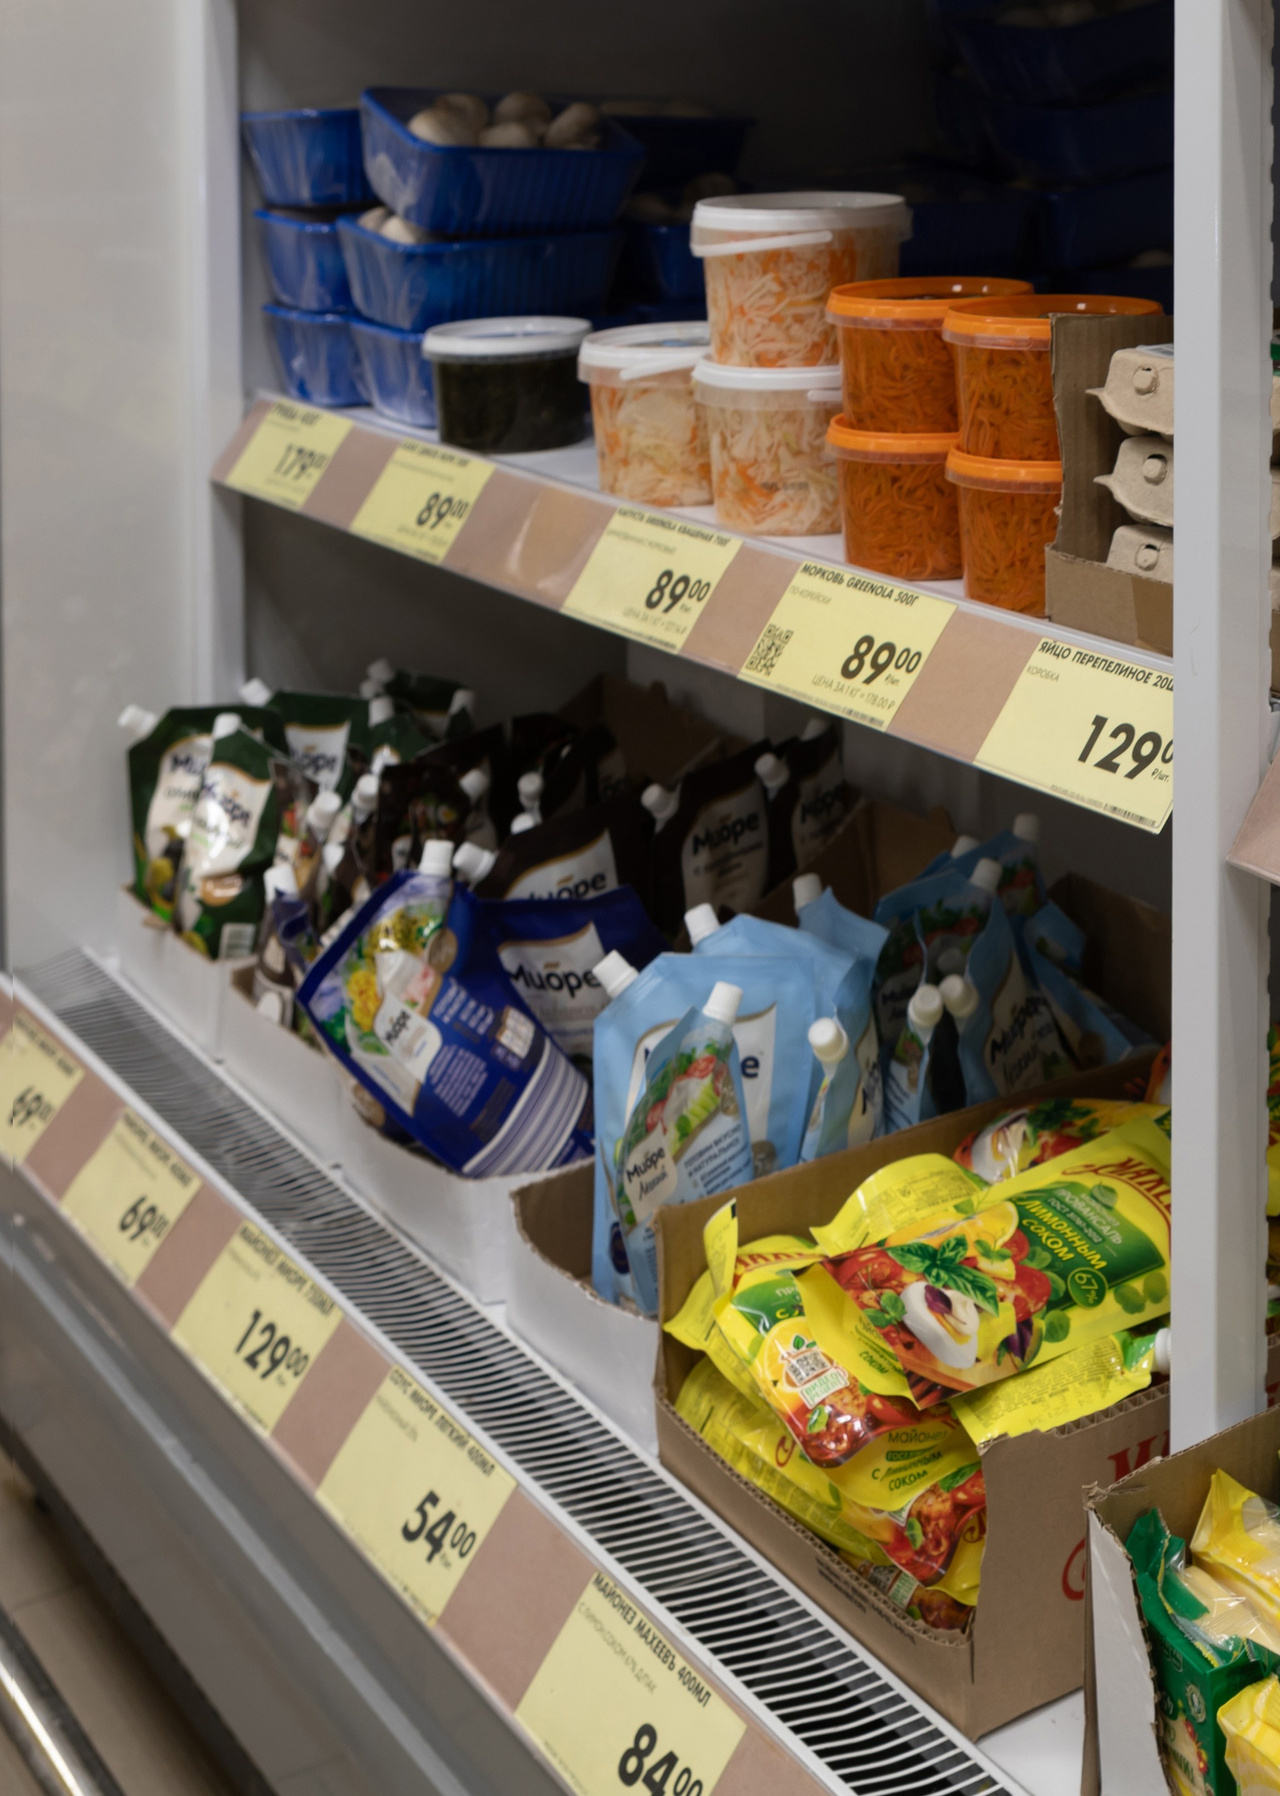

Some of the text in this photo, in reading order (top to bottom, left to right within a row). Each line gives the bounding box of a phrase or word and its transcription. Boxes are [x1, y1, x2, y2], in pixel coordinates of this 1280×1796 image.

[416, 491, 454, 530] 89
[645, 569, 711, 613] 89 00
[801, 563, 919, 606] МОРКОВЬ GREENOLA 500Г
[840, 634, 922, 685] 89 00
[1026, 664, 1060, 683] КОРОБКА
[1038, 639, 1071, 660] ЯЙЦО
[1072, 651, 1153, 684] ПЕРЕПЕЛИНОЕ
[811, 673, 834, 690] ЦЕНА
[832, 680, 845, 692] ЗА
[848, 684, 860, 697] КГ
[1077, 714, 1162, 780] 129
[626, 1147, 666, 1183] Миоре
[119, 1195, 158, 1242] 69
[235, 1308, 291, 1379] 129
[402, 1489, 477, 1564] 54 00
[592, 1574, 712, 1707] МАЙОНЕЗ МАХЕЕВЪ 400МЛ
[618, 1723, 680, 1796] 84
